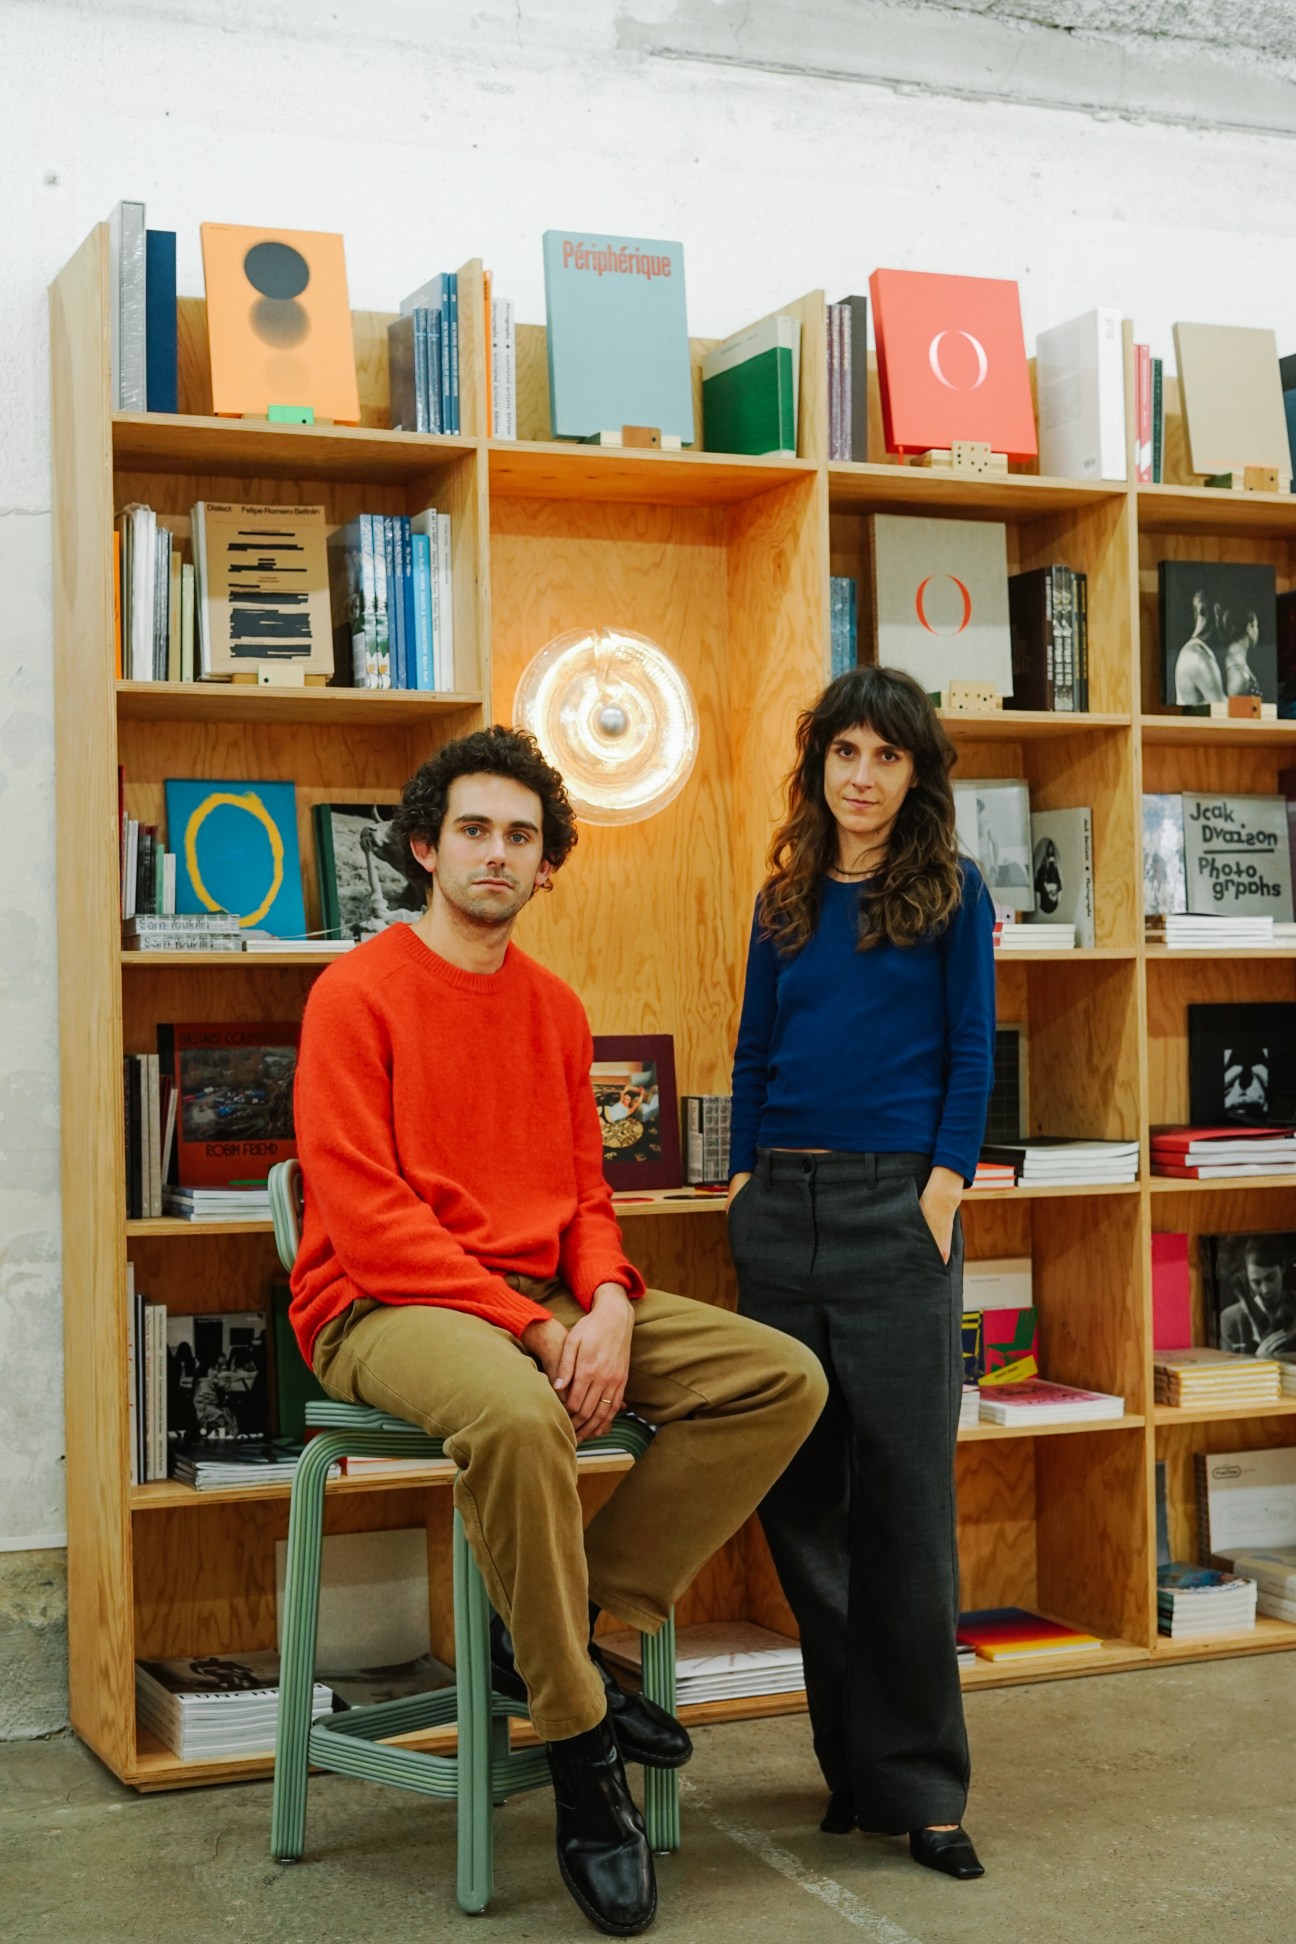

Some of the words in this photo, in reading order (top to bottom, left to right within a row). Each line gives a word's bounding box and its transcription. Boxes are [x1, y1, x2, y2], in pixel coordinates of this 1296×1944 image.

[562, 239, 672, 281] Périphérique
[207, 504, 232, 513] Dialect
[241, 505, 263, 515] Felipe
[264, 506, 293, 515] Romero
[294, 507, 320, 516] Beltrán
[1198, 856, 1257, 880] Photo
[139, 918, 166, 930] Sam
[206, 1143, 240, 1157] ROBIN
[242, 1142, 277, 1156] FRIEND
